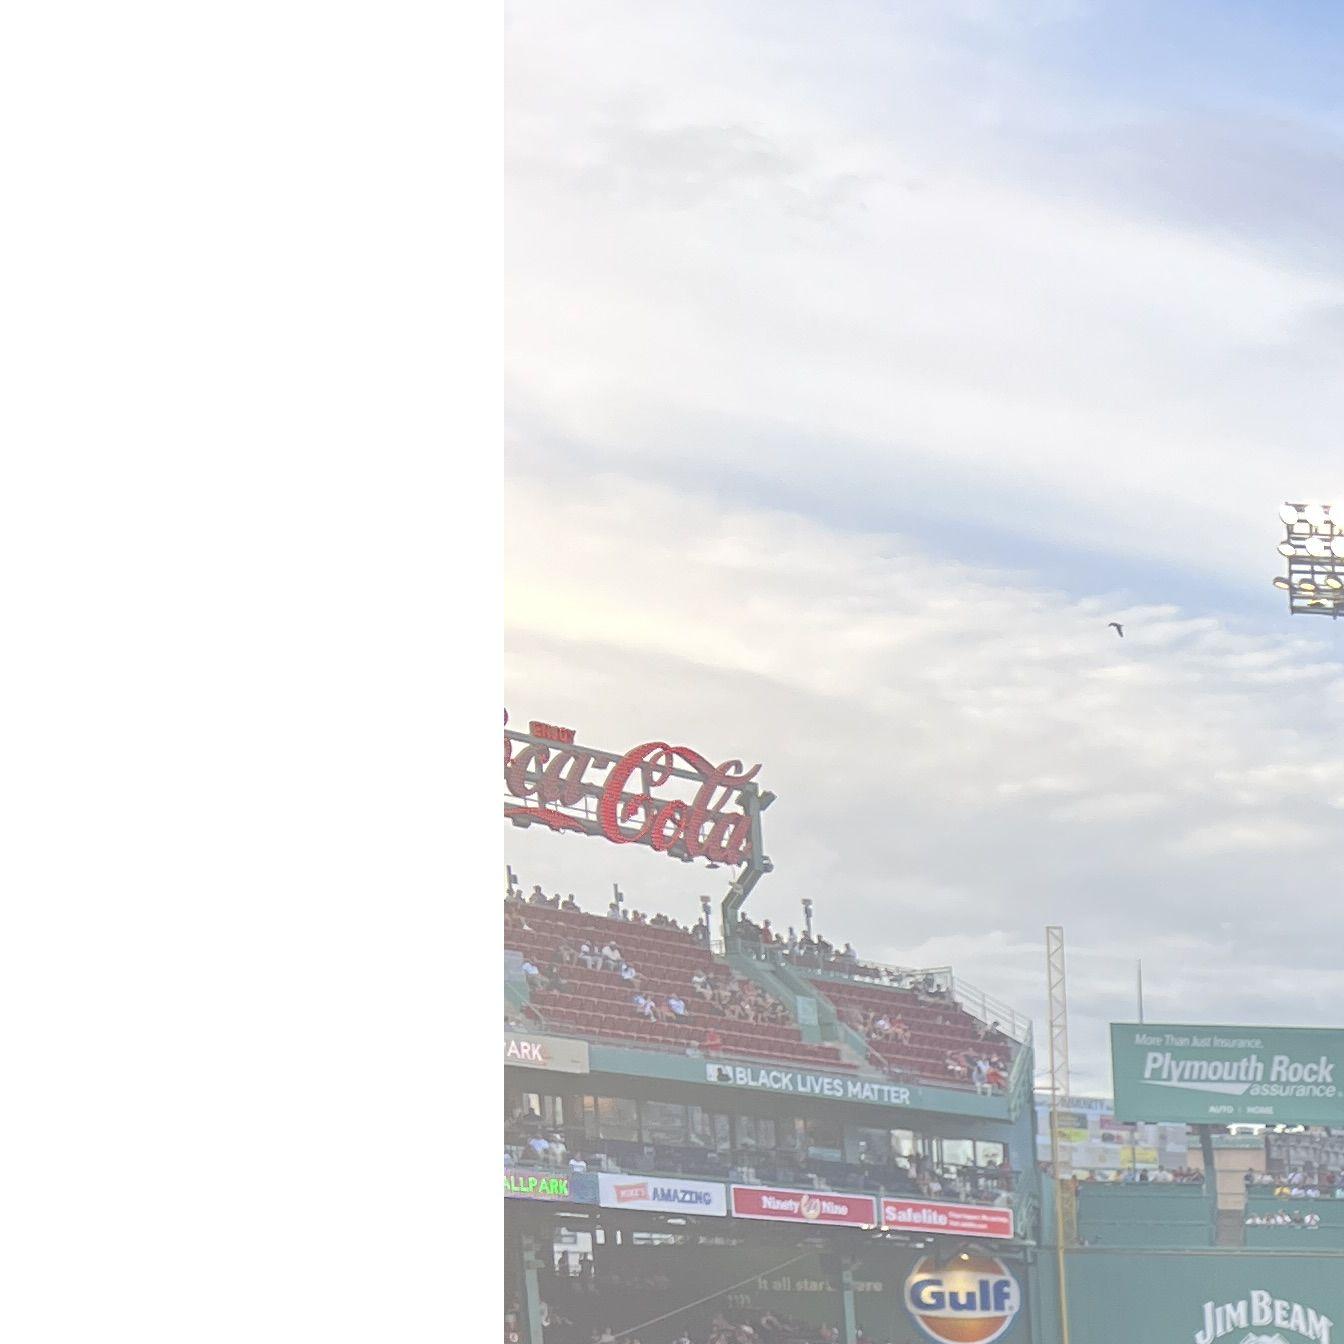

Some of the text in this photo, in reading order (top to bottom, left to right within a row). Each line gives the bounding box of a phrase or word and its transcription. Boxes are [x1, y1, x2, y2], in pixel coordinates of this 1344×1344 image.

[504, 1040, 543, 1061] ARK
[1134, 1034, 1163, 1046] More
[1164, 1034, 1190, 1047] Than
[1190, 1035, 1211, 1048] Just
[1143, 1052, 1335, 1083] Plymouth Rock
[735, 1067, 911, 1104] BLACK LIVES MATTER
[1249, 1083, 1337, 1098] assurance
[652, 1187, 712, 1205] AMAZING
[761, 1195, 801, 1216] Ninety
[822, 1201, 848, 1216] Nine
[885, 1206, 948, 1226] Safelite
[909, 1279, 1011, 1312] Gulf
